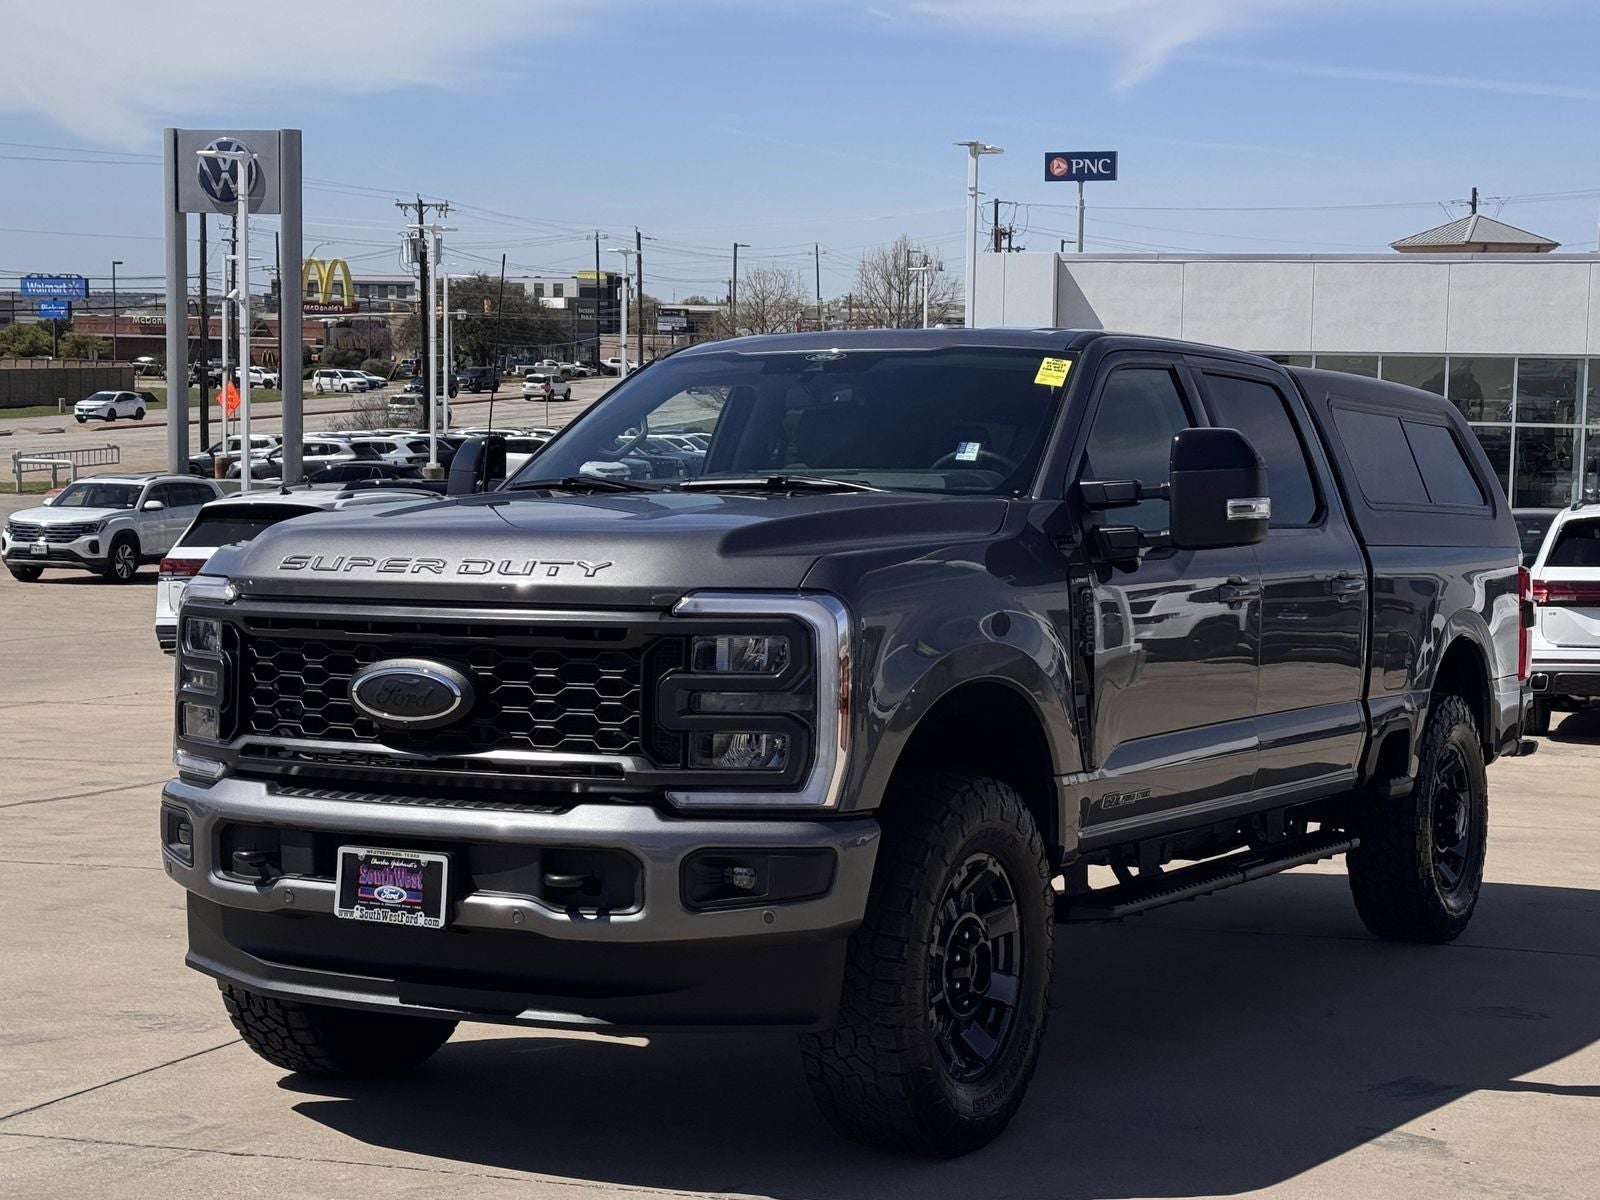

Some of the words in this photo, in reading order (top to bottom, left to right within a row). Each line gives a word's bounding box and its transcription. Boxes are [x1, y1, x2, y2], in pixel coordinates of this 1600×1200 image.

[1071, 158, 1111, 174] PNC
[26, 282, 67, 294] Walmart
[278, 555, 448, 575] SUPER
[456, 559, 614, 577] DUTY
[375, 678, 435, 709] Ford
[380, 888, 400, 900] Ford
